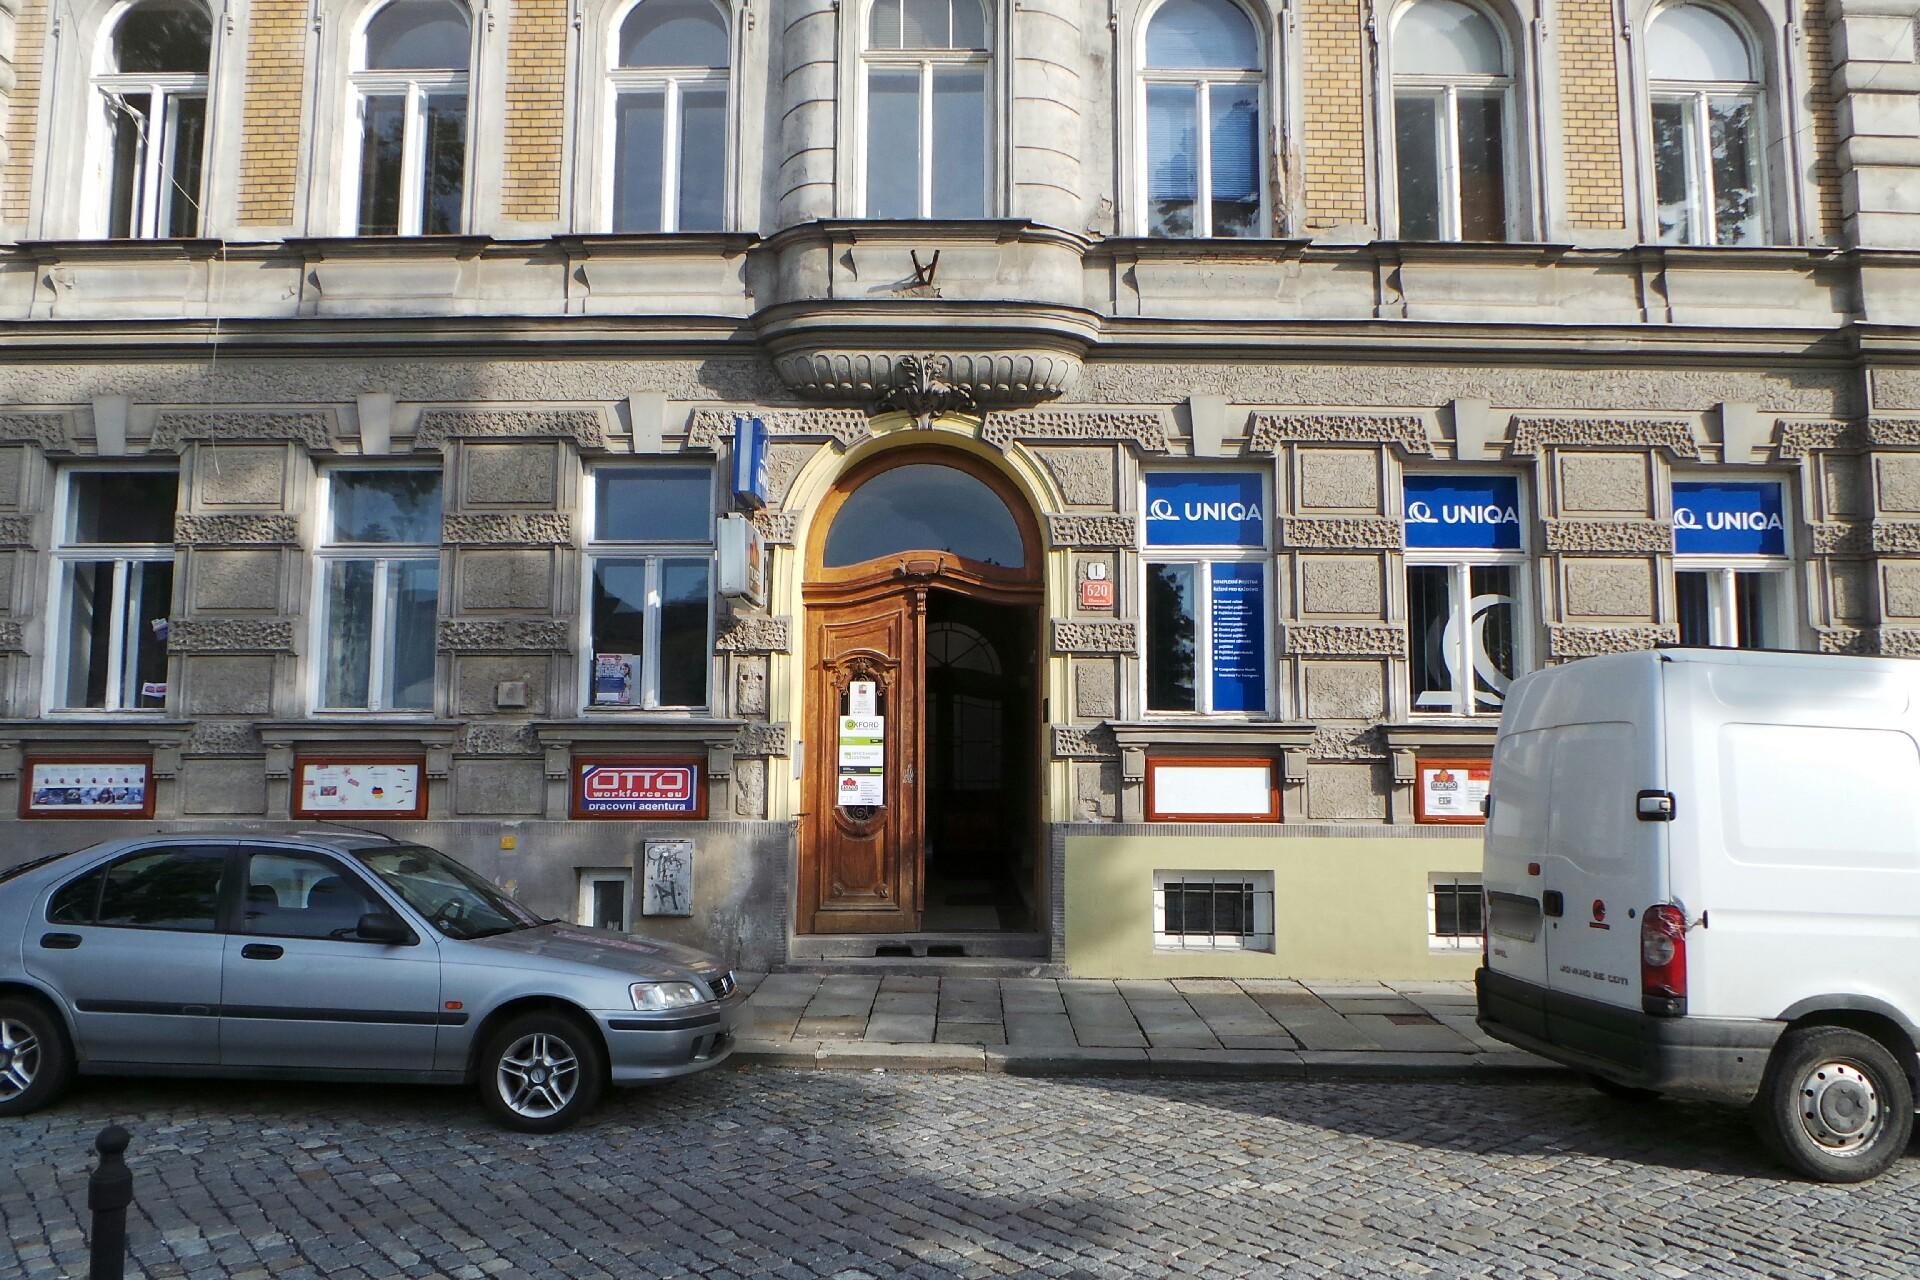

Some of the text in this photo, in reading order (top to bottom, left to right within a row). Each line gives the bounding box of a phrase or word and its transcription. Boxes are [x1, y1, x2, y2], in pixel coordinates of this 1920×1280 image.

[1184, 503, 1262, 521] UNIQA
[1442, 506, 1519, 524] UNIQA
[1706, 512, 1784, 530] UNIQA
[1087, 584, 1108, 597] 620
[847, 721, 879, 729] OXFORD
[592, 772, 683, 789] OTTO
[593, 790, 682, 798] workforce.eu
[589, 802, 686, 811] pracovní agentura
